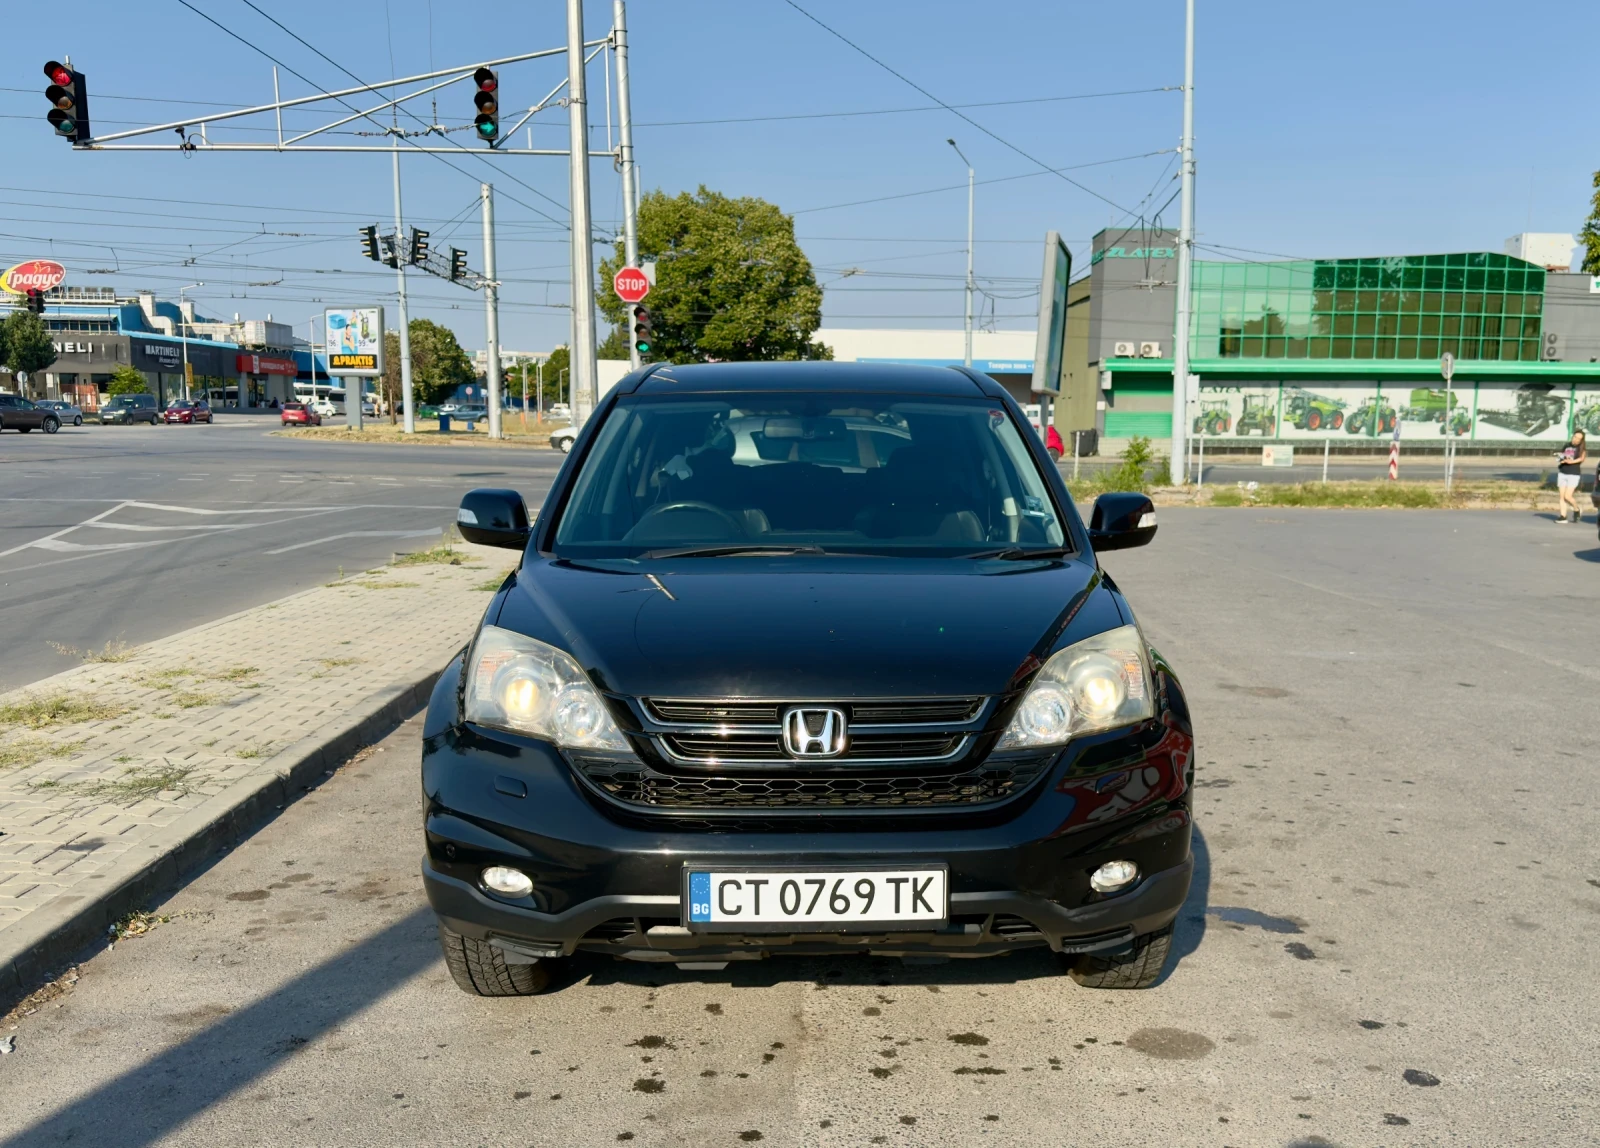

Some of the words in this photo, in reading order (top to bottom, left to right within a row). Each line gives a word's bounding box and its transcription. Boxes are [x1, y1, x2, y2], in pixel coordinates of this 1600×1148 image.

[1106, 247, 1178, 258] ZLATEX
[6, 270, 60, 289] Градус
[617, 278, 646, 291] STOP
[145, 345, 180, 357] MARTINELI
[340, 355, 374, 366] PRAKTIS
[718, 879, 769, 915] CT
[779, 878, 876, 915] 0769
[885, 876, 935, 914] TK
[692, 903, 710, 915] BG
